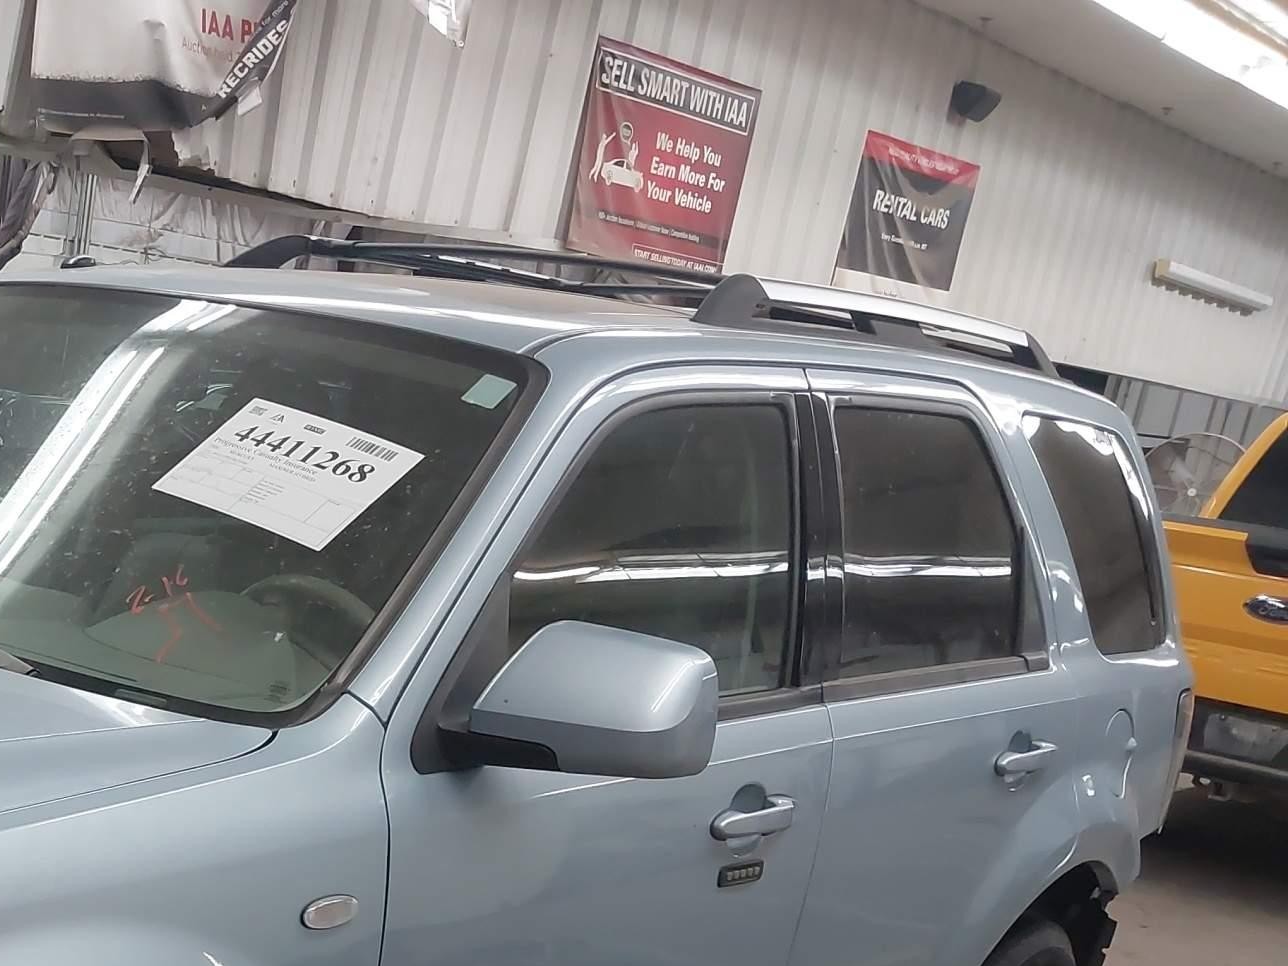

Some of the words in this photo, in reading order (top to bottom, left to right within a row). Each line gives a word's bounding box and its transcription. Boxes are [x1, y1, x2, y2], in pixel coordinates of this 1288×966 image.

[201, 8, 234, 41] IAA
[601, 56, 635, 91] SELL
[637, 65, 690, 107] SMART
[688, 85, 723, 118] WITH
[723, 96, 749, 127] IAA
[656, 131, 673, 153] We
[675, 137, 700, 163] Help
[703, 144, 722, 167] You
[650, 157, 676, 180] Earn
[678, 164, 706, 189] More
[707, 173, 726, 193] For
[647, 180, 672, 204] Your
[674, 187, 713, 214] Vehicle
[872, 189, 918, 221] RENTAL
[920, 205, 951, 229] CARS
[233, 425, 376, 483] 44411268
